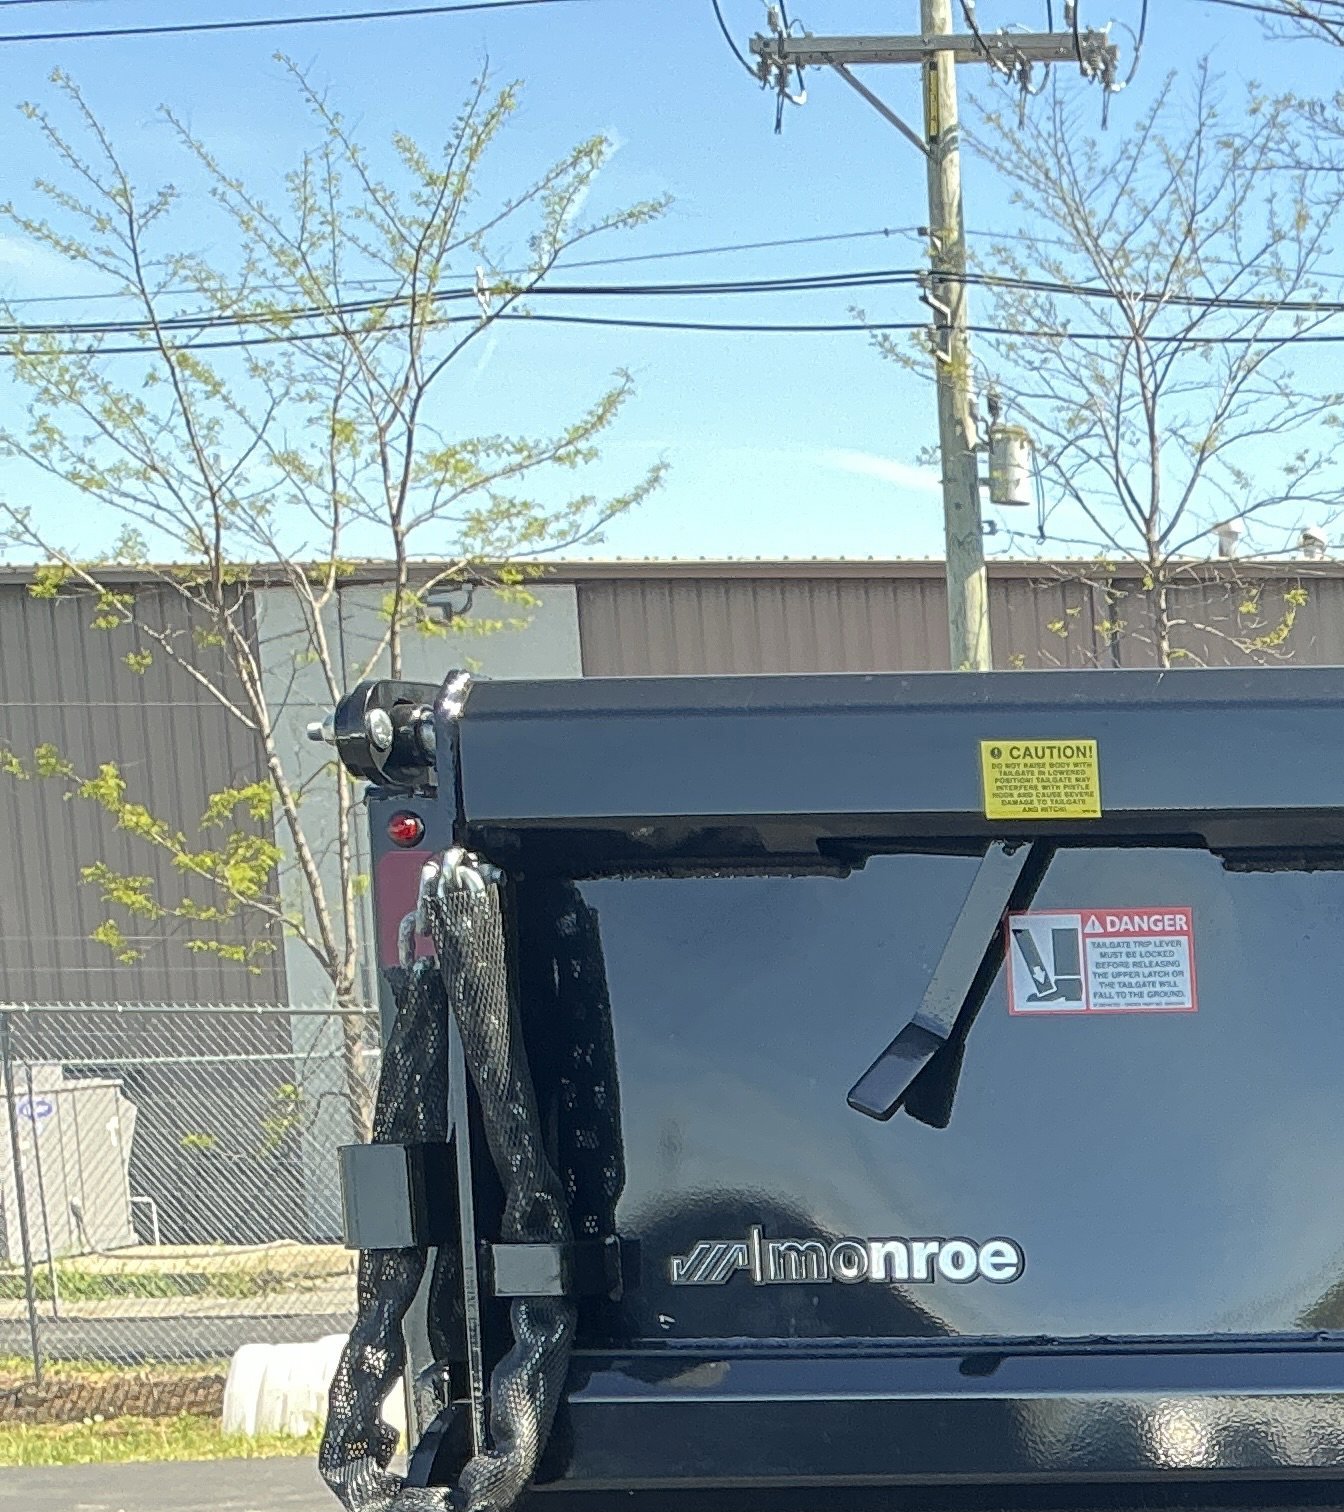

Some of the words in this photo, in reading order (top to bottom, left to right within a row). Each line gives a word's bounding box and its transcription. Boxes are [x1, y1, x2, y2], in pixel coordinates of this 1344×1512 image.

[1009, 745, 1093, 760] CAUTION!
[1106, 914, 1189, 932] DANGER
[769, 1239, 1020, 1282] monroe
